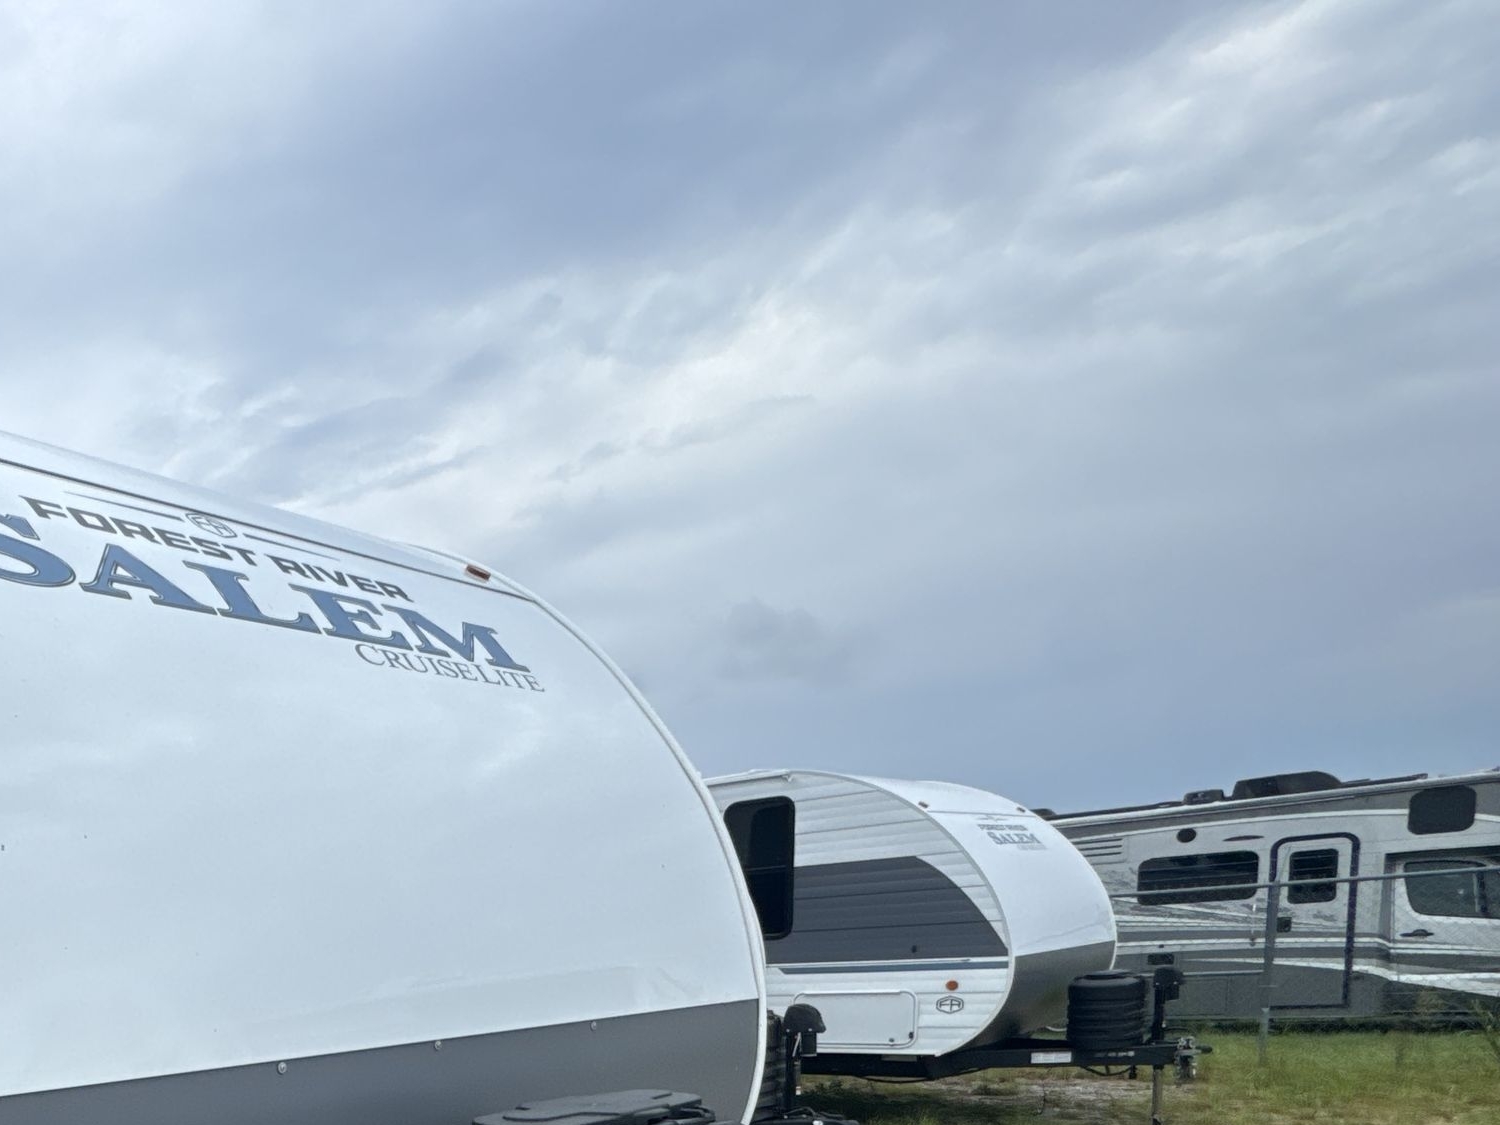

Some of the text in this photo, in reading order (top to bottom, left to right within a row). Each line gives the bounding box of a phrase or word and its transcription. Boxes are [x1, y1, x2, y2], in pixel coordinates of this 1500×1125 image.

[19, 495, 414, 602] FOREST RIVER
[355, 643, 545, 692] CRUISELITE
